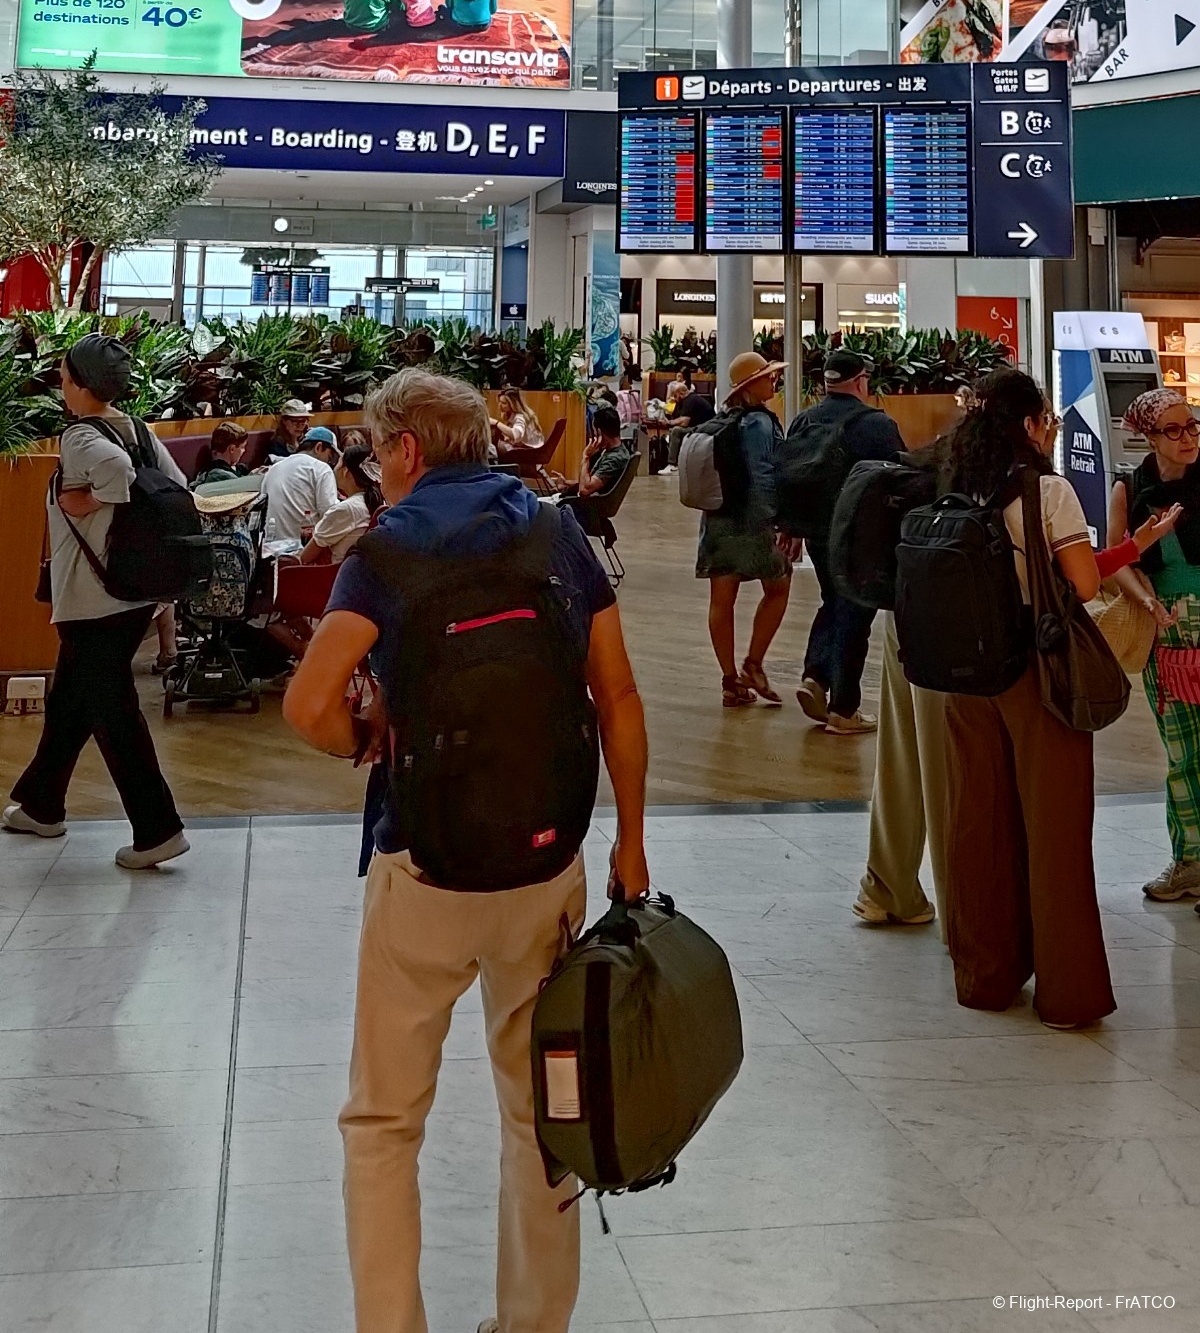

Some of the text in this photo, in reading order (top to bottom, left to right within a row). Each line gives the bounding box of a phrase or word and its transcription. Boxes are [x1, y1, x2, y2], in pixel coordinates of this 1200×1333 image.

[33, 11, 130, 26] destinations
[436, 44, 559, 67] transavia
[1105, 48, 1129, 77] BAR
[437, 64, 559, 77] vous savez avec qui partir
[991, 69, 1018, 77] Portes
[709, 80, 772, 97] Départs
[788, 78, 881, 96] Departures
[898, 76, 927, 91] 出发
[1001, 110, 1020, 135] B
[271, 128, 373, 154] Boarding
[395, 130, 438, 153] 登机
[528, 125, 547, 155] F
[1000, 152, 1021, 178] C
[576, 181, 618, 191] LONGINES
[674, 292, 716, 302] LONGINES
[1110, 349, 1145, 363] ATM
[1072, 431, 1093, 451] ATM
[1070, 454, 1096, 474] Retrait
